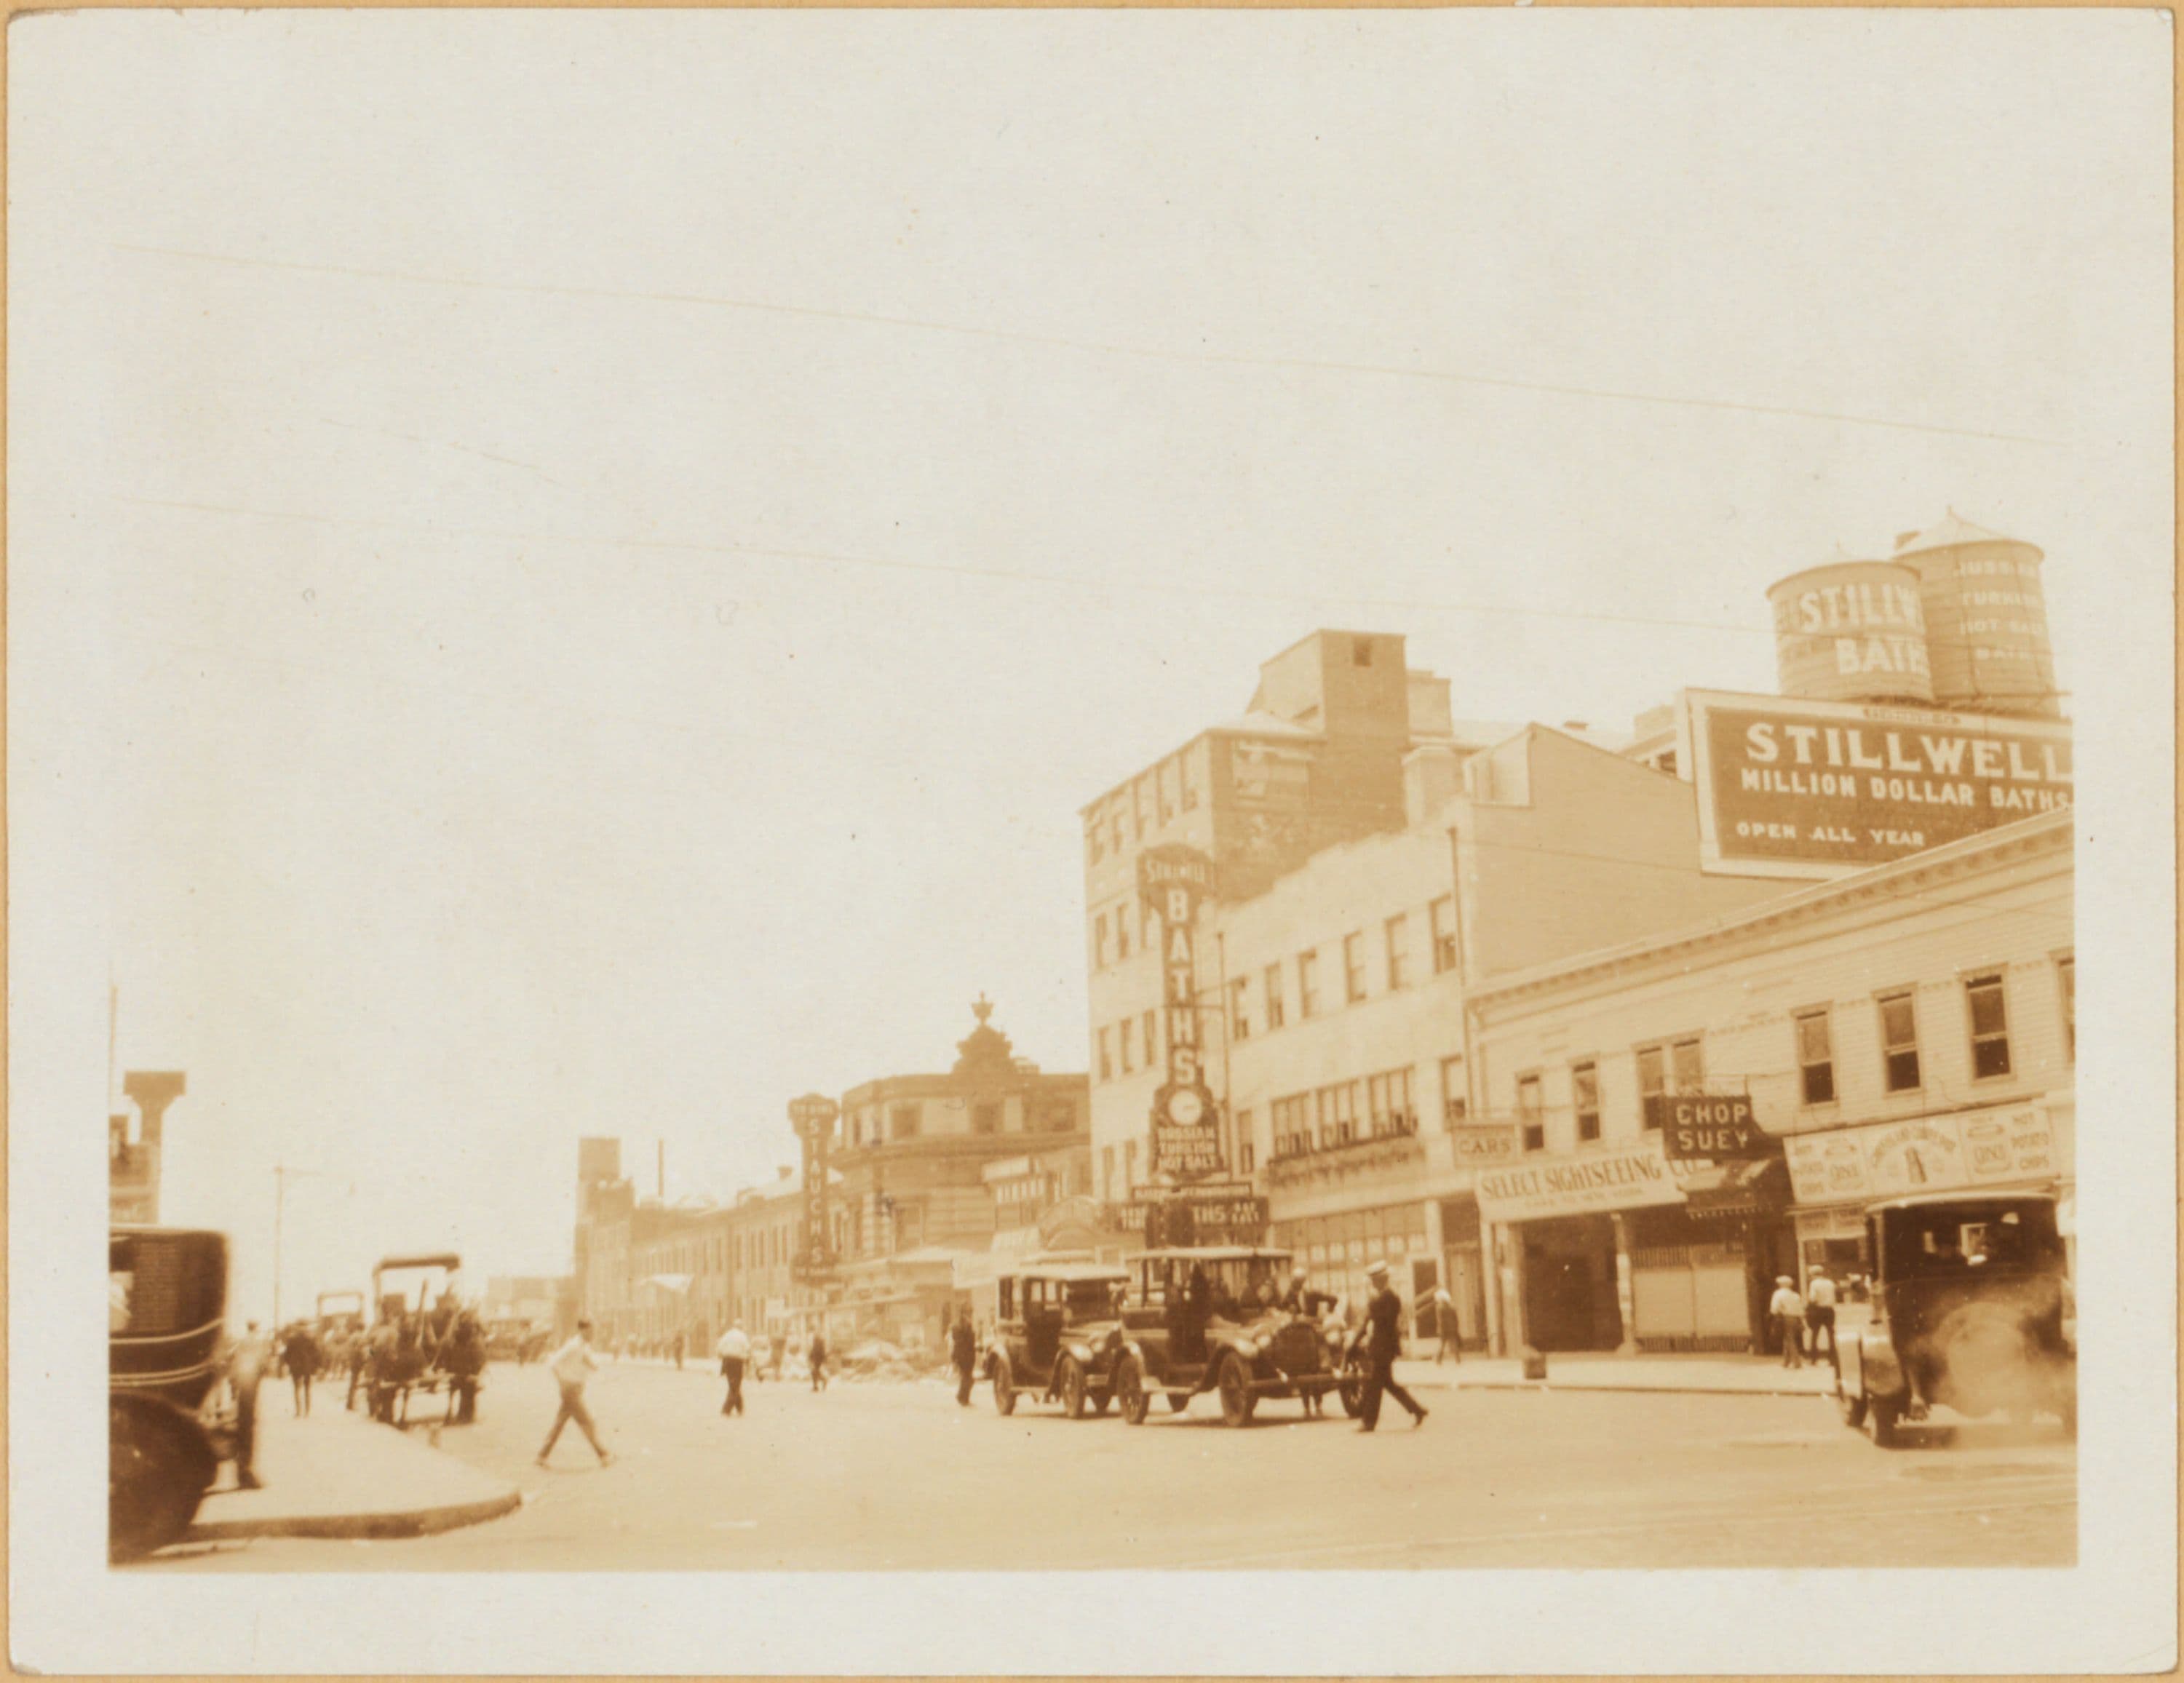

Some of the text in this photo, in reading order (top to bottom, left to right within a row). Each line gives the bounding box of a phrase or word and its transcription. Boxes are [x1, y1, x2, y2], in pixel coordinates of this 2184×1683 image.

[1746, 723, 2073, 783] STILLWELL
[1741, 768, 2069, 811] MILLION DOLLAR BATHS
[1736, 821, 1926, 847] OPEN ALL YEAR
[1167, 888, 1198, 1085] BATHS
[1676, 1103, 1748, 1125] CHOP
[1460, 1135, 1511, 1155] CARS
[1677, 1131, 1748, 1151] SUEY
[1482, 1169, 1540, 1199] SELECT
[1544, 1154, 1661, 1193] SIGHTSEEING
